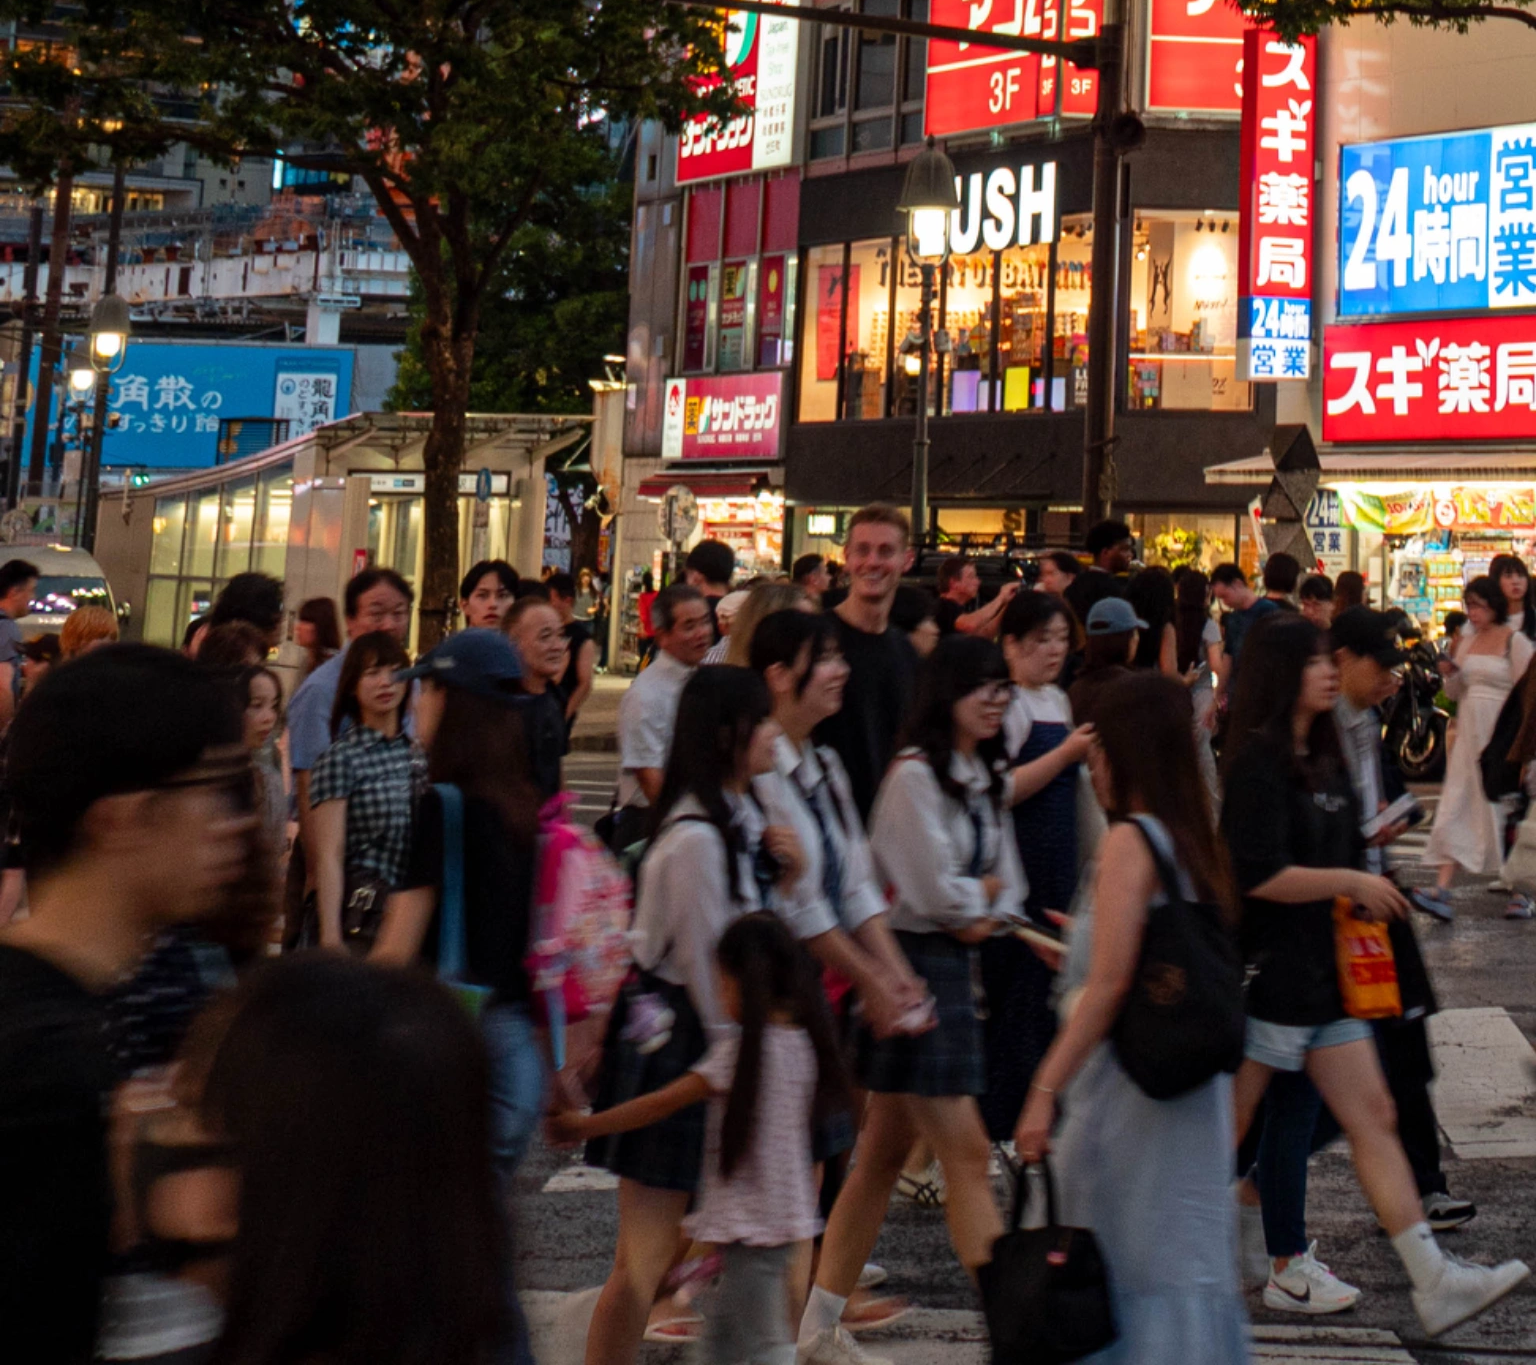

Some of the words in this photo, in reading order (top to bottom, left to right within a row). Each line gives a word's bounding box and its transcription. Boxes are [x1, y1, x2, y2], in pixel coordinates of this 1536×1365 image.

[988, 68, 1021, 114] 3F
[1071, 78, 1093, 95] 3F
[1258, 40, 1312, 291] スギ薬局
[1422, 165, 1480, 205] hour
[1251, 343, 1307, 378] 営業
[710, 394, 778, 433] サンドラッグ
[1313, 530, 1341, 553] 営業
